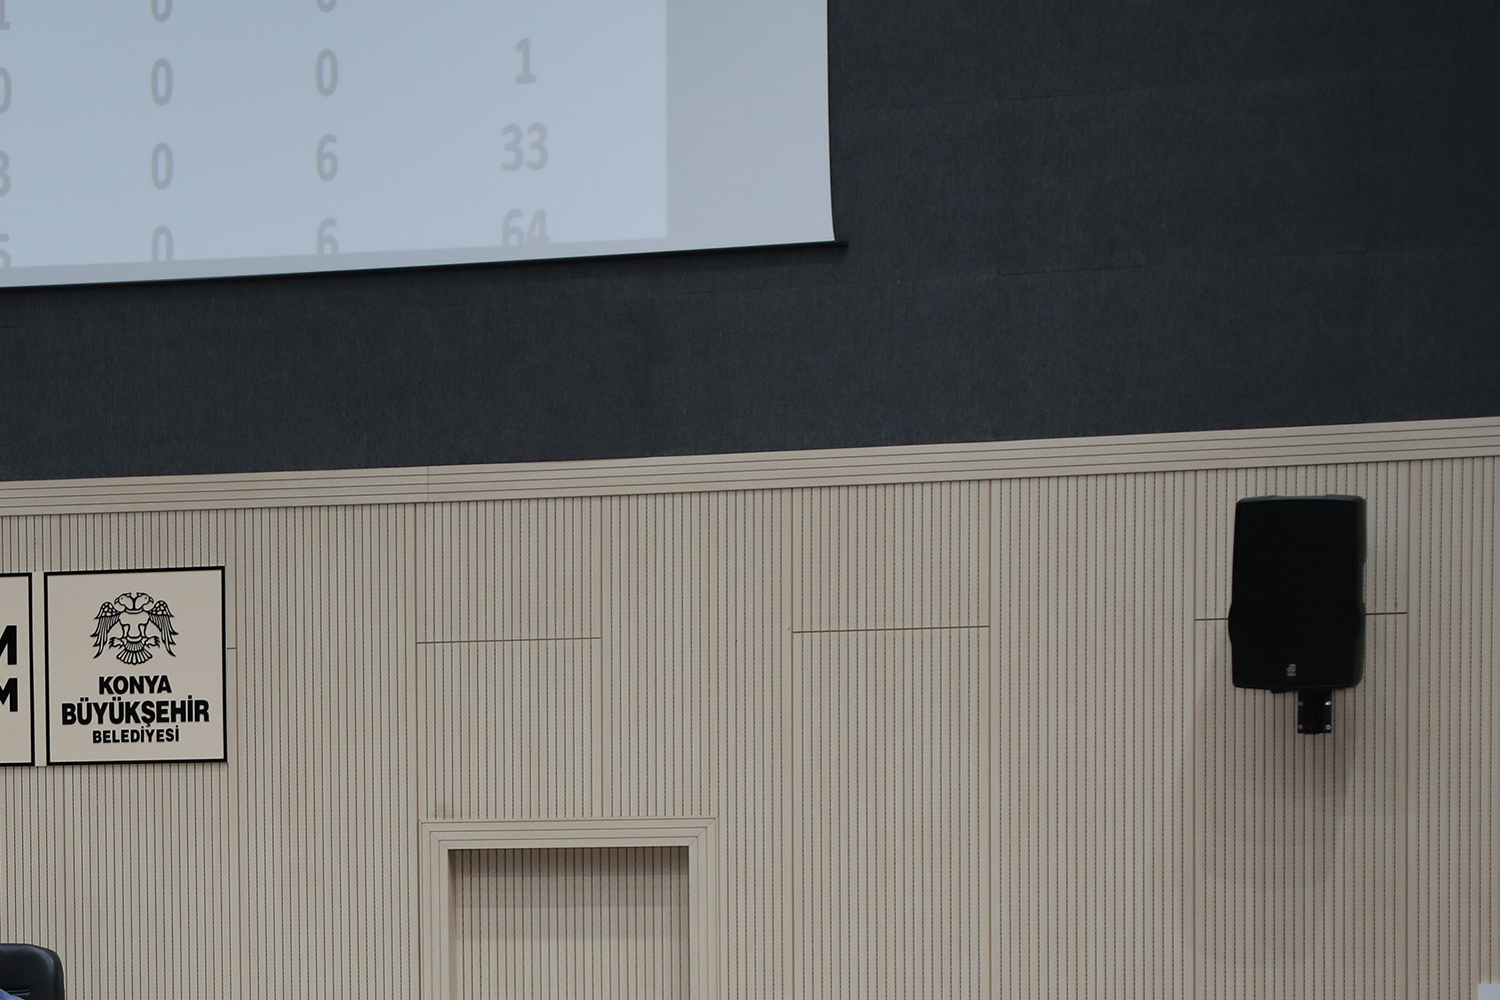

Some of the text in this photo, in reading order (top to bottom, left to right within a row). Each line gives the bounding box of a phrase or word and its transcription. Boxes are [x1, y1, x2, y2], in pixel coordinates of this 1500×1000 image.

[151, 58, 174, 106] 0
[315, 48, 338, 97] 0
[514, 38, 537, 84] 1
[151, 142, 174, 190] 0
[316, 133, 339, 181] 6
[502, 122, 549, 172] 33
[316, 217, 339, 254] 6
[502, 208, 550, 246] 64
[98, 675, 172, 695] KONYA
[61, 694, 211, 727] BÜYÜKŞEHİR
[92, 725, 180, 744] BELEDİYESİ
